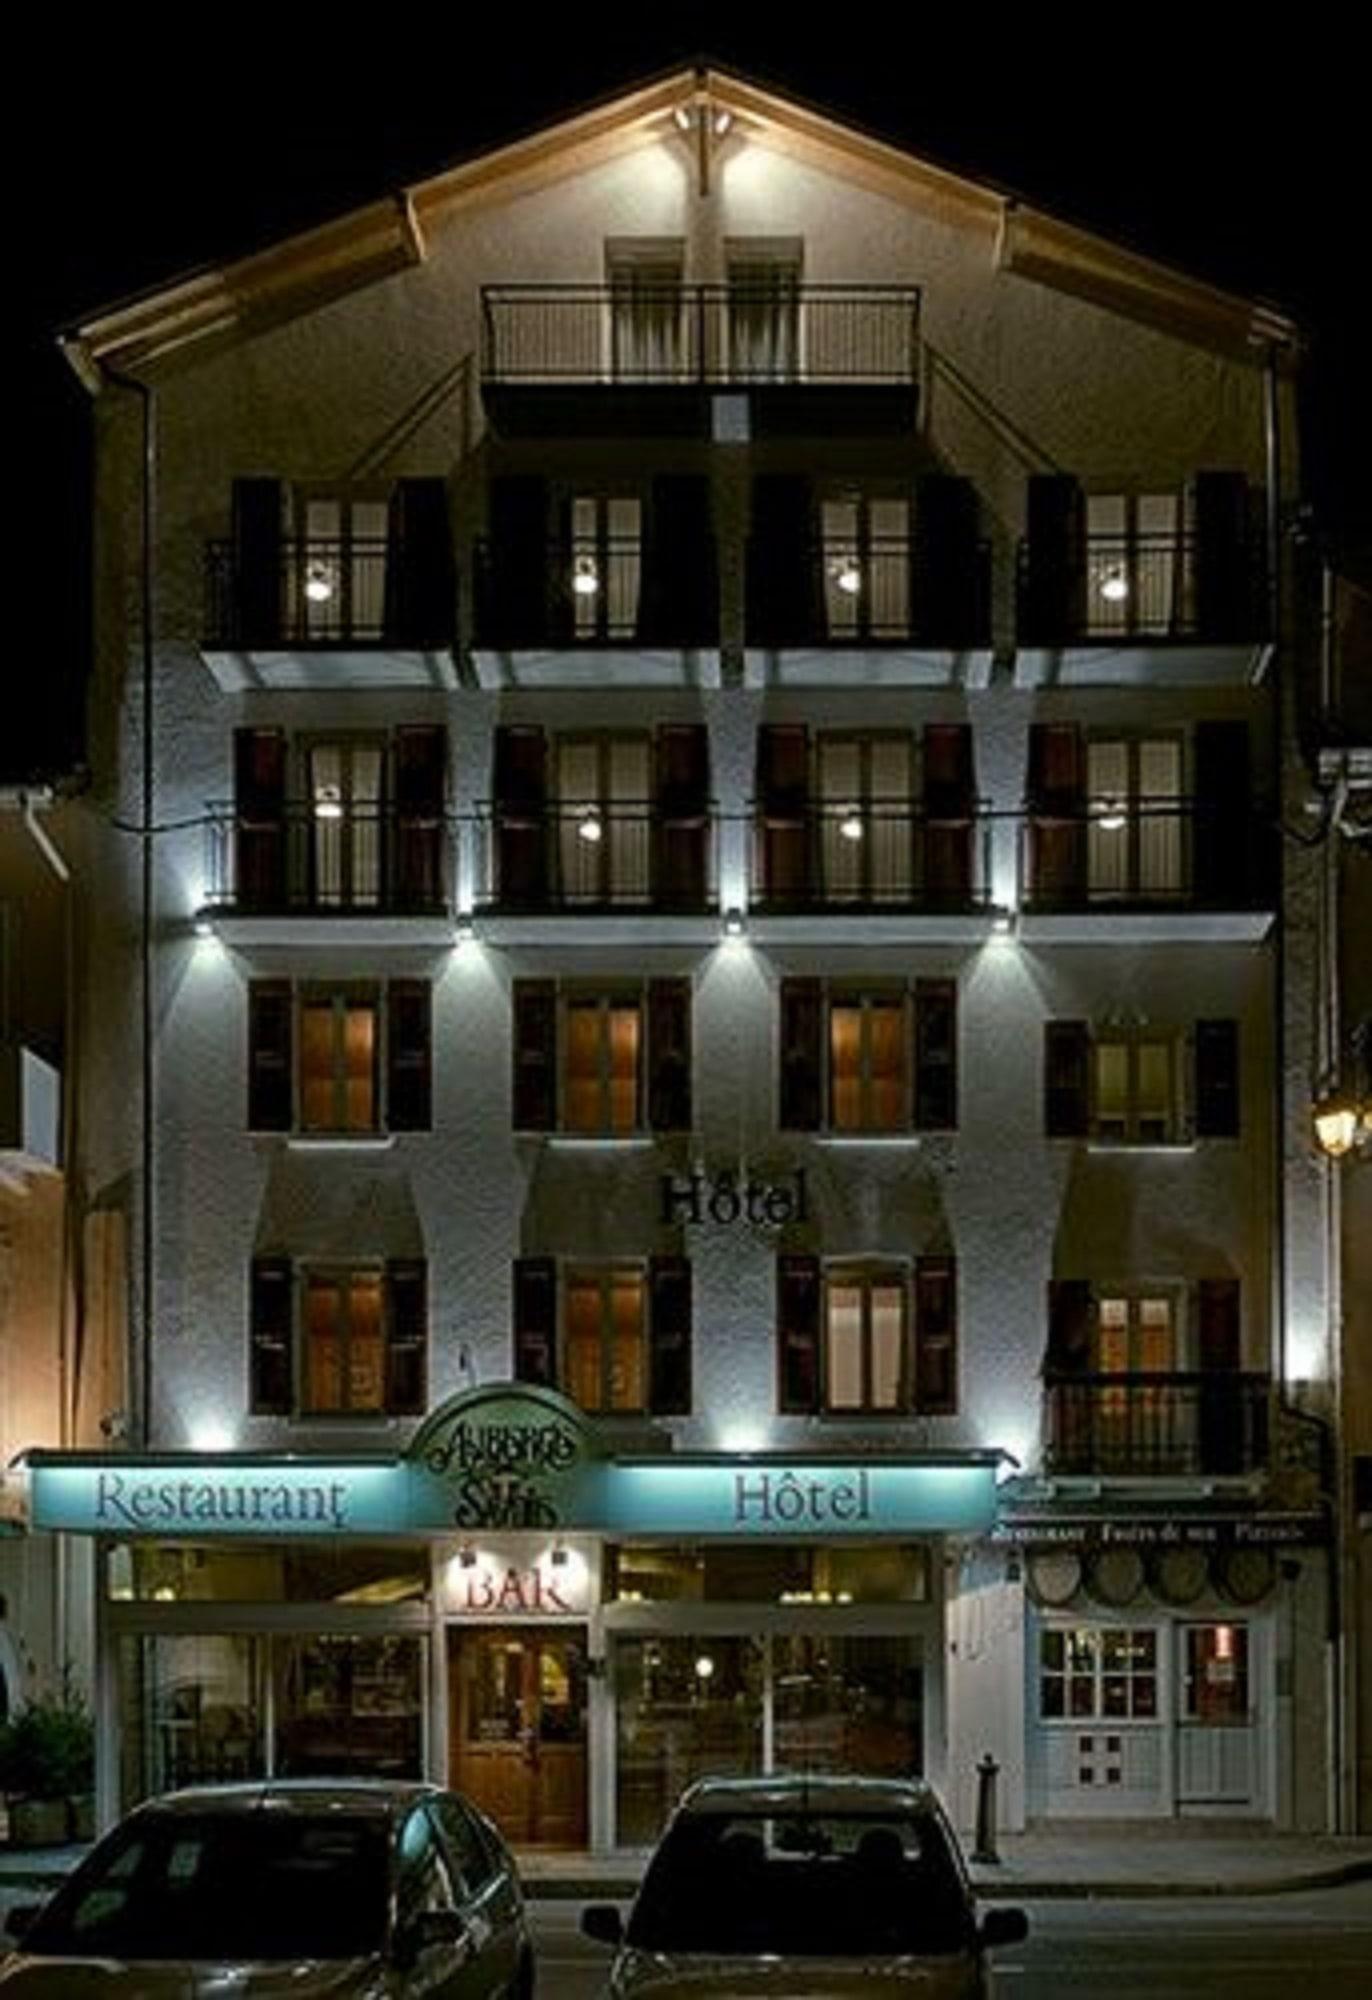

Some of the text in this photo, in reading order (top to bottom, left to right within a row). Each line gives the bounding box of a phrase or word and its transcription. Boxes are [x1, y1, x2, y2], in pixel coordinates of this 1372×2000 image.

[660, 1168, 808, 1224] Hôtel
[95, 1473, 347, 1528] Restaurant
[735, 1472, 869, 1520] Hôtel
[465, 1567, 572, 1611] BAR
